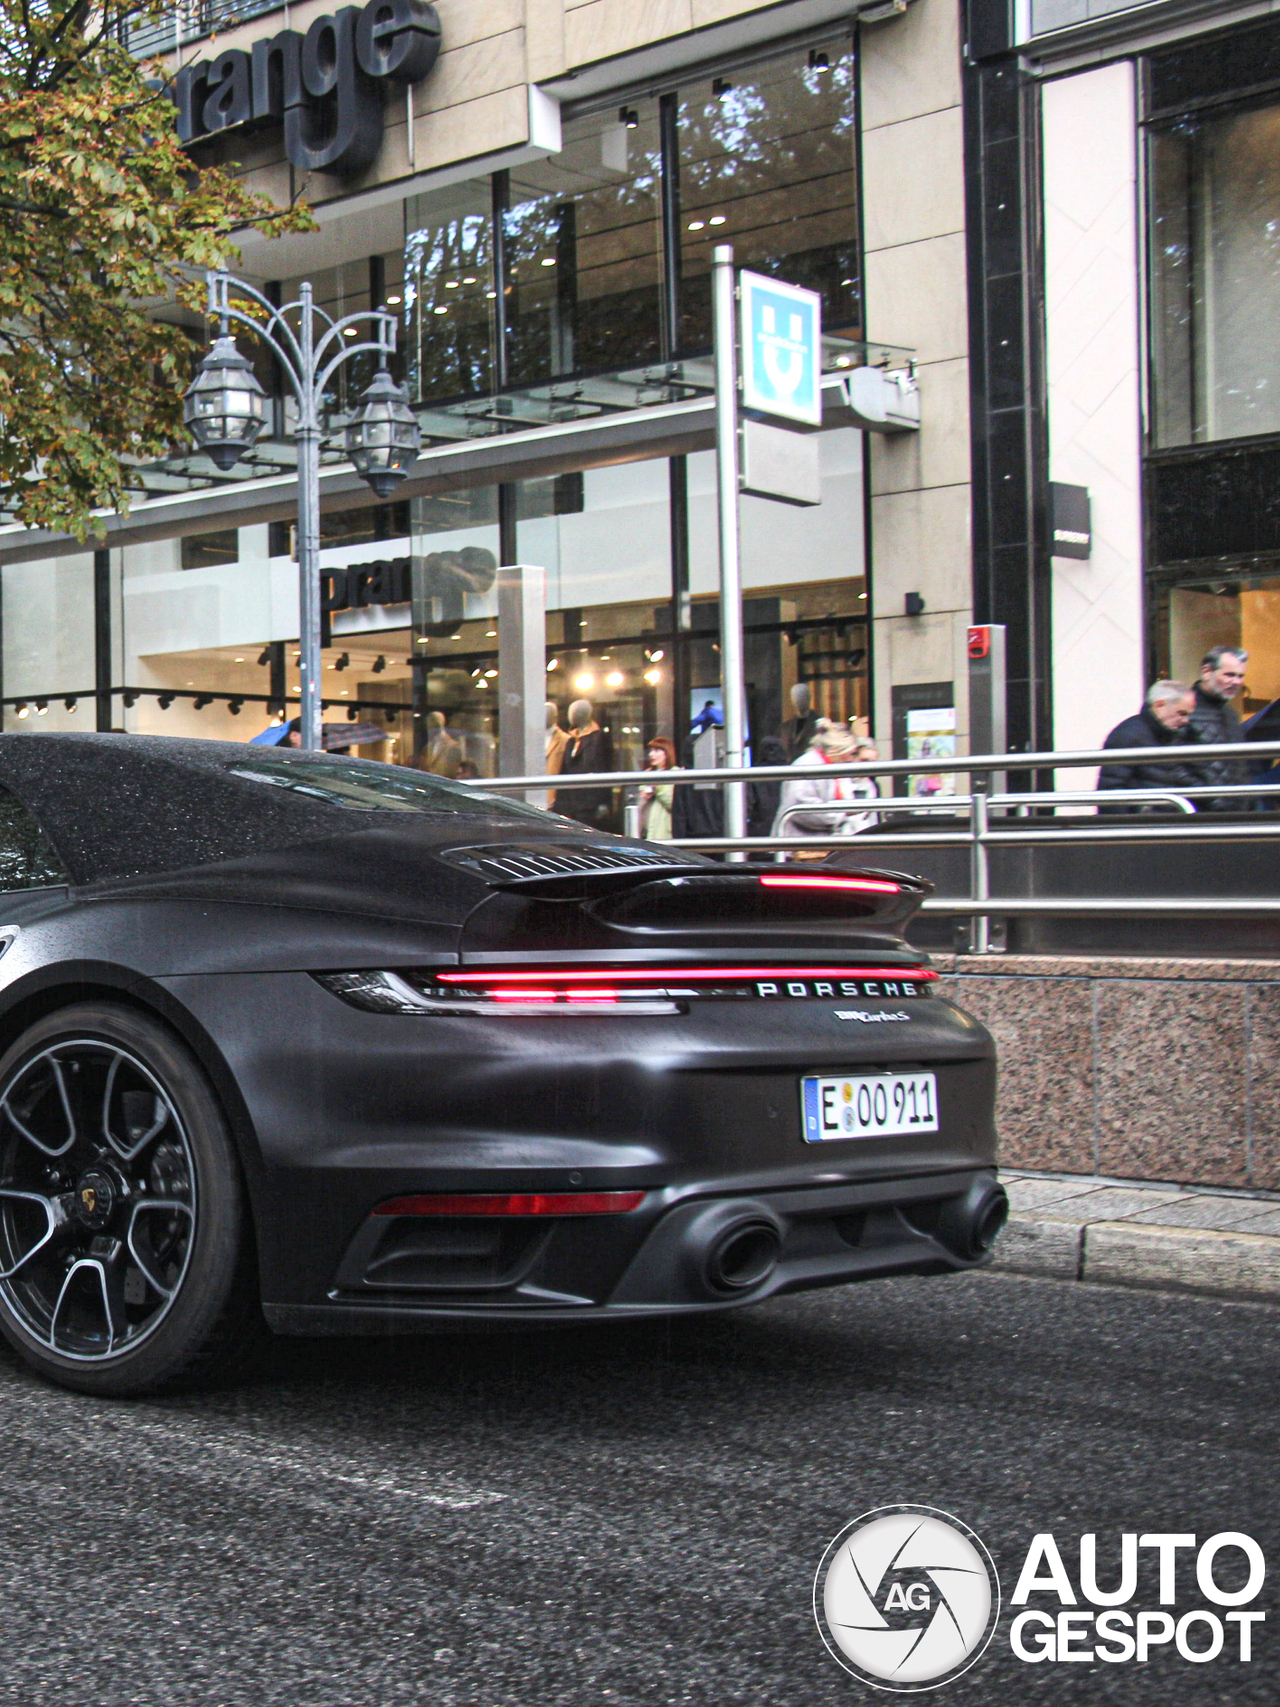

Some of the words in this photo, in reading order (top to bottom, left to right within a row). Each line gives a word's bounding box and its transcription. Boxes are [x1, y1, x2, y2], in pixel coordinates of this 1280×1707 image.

[142, 0, 442, 172] range
[756, 982, 918, 998] PORSCHE
[822, 1085, 838, 1130] E
[894, 1081, 933, 1124] 911
